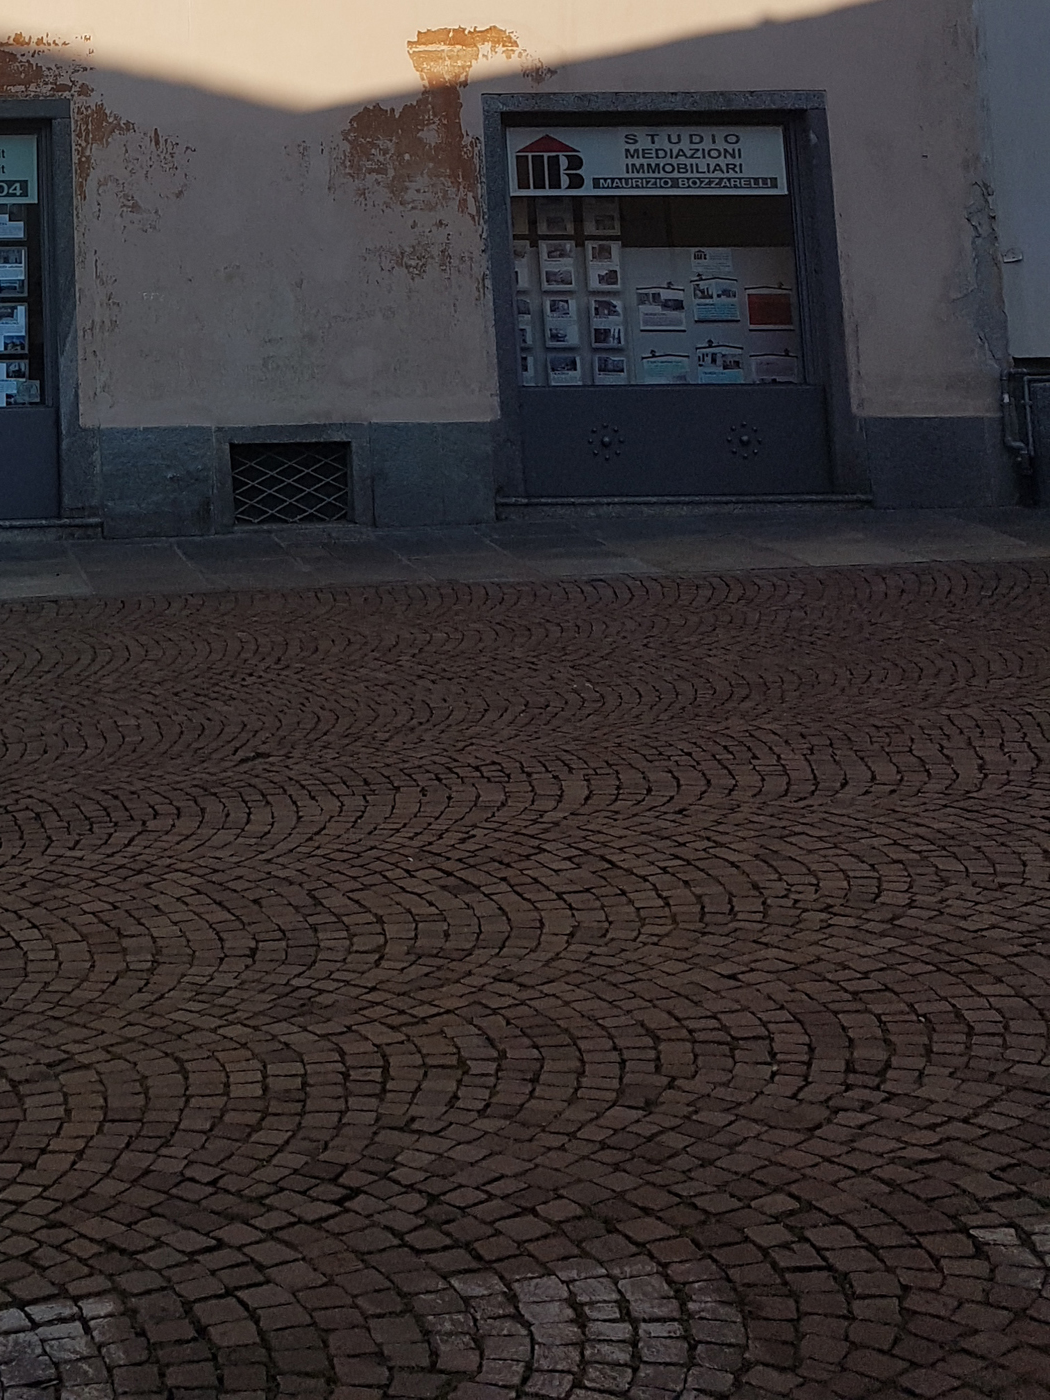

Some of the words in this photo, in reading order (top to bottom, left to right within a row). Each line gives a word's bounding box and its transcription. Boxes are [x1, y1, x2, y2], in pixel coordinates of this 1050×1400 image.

[624, 133, 741, 145] STUDIO
[624, 148, 742, 160] MEDIAZIONI
[625, 162, 744, 175] IMMOBILIARI
[599, 178, 672, 189] MAURIZIO
[678, 177, 772, 188] BOZZARELLI
